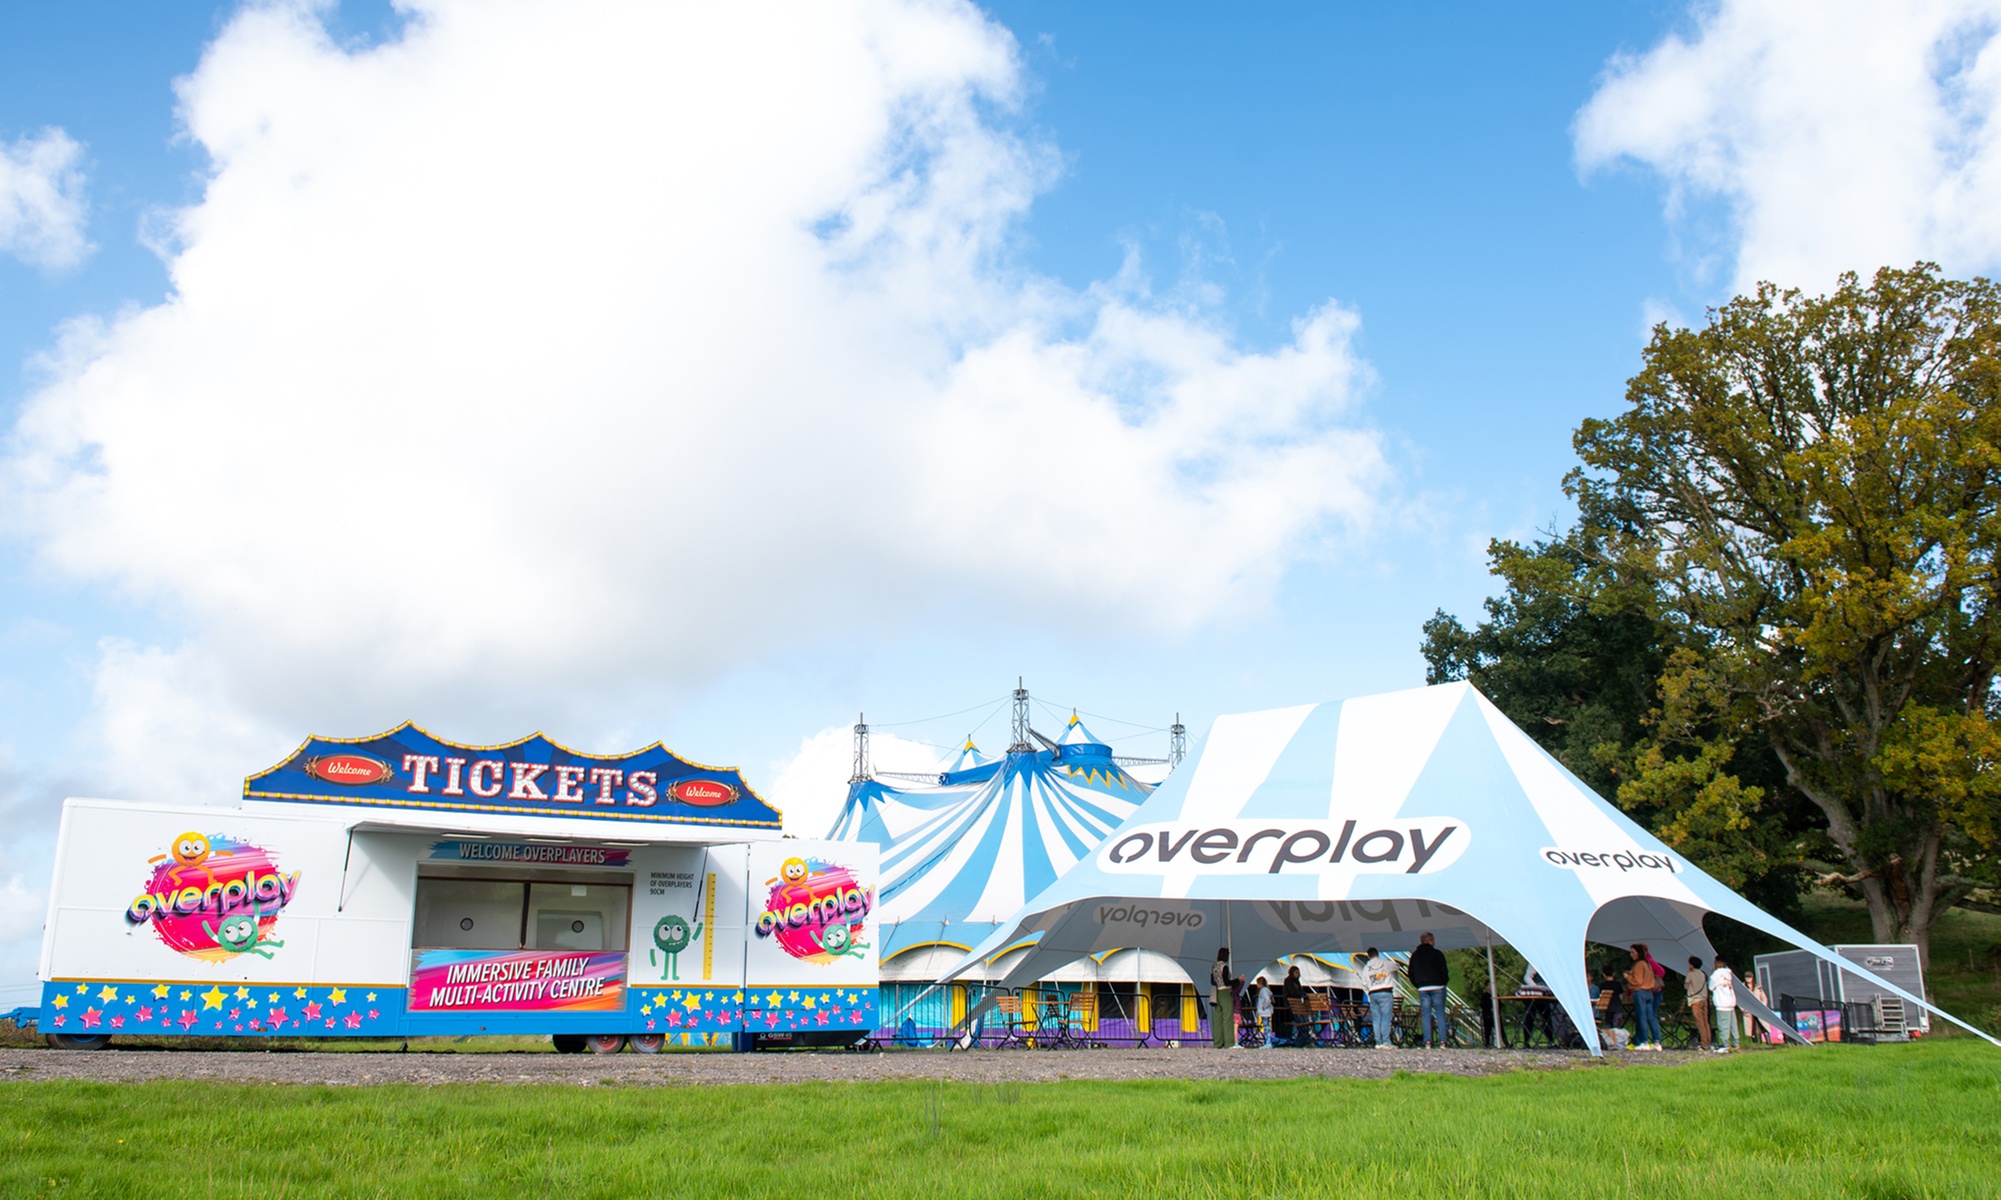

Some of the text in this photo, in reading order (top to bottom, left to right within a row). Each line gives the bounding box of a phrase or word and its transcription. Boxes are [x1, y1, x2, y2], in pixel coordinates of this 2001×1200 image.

[327, 761, 372, 777] Welcome
[403, 754, 658, 807] TICKETS
[685, 786, 722, 799] Welcome
[459, 843, 606, 864] WELCOME OVERPLAYERS
[1109, 820, 1457, 874] overplay
[1546, 850, 1676, 874] overplay
[127, 870, 302, 924] overplay
[756, 884, 876, 937] overplay
[446, 957, 589, 984] IMMERSIVE FAMILY
[429, 977, 604, 1007] MULTI-ACTIVITY CENTRE
